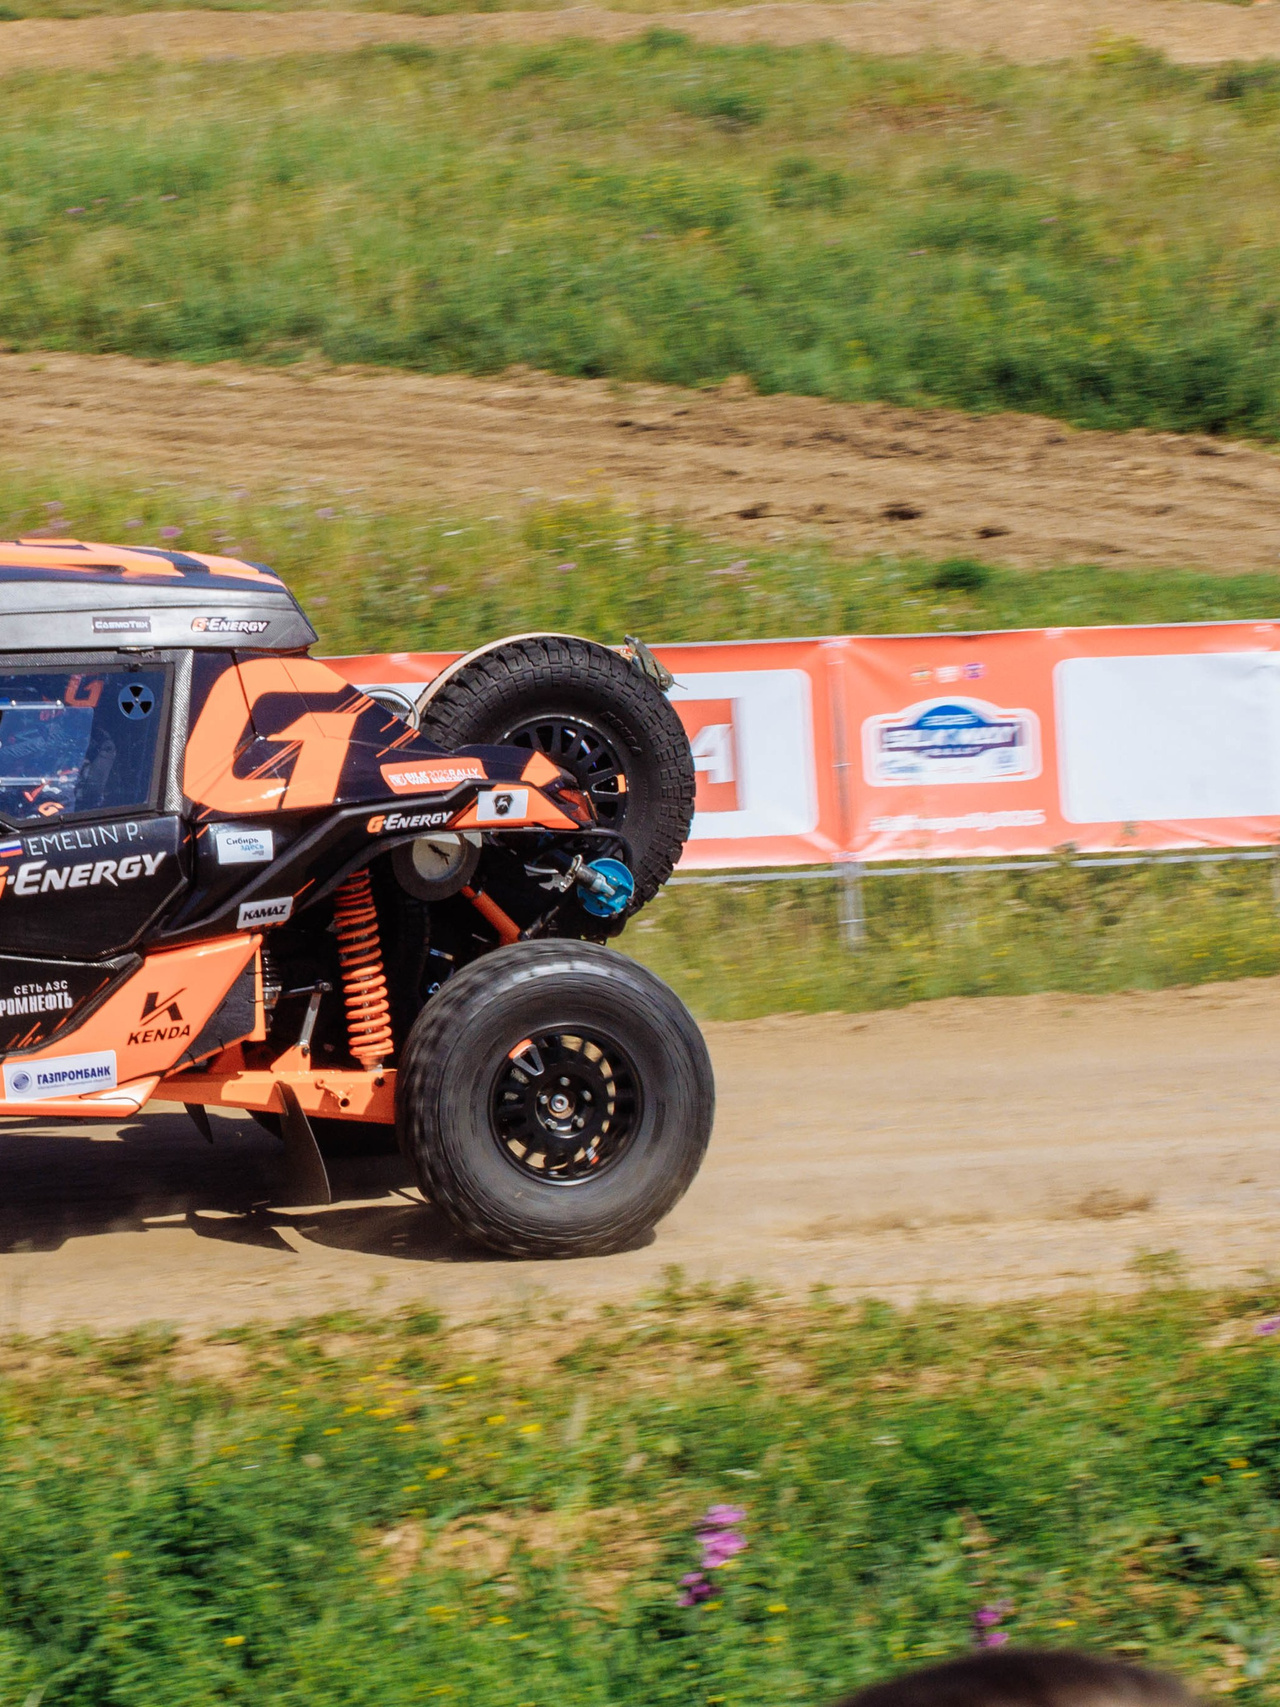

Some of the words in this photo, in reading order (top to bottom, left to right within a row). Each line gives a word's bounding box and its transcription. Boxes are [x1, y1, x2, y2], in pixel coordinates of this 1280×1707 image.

[366, 811, 455, 834] G-ENERGY
[27, 825, 119, 857] EMELIN
[127, 821, 145, 842] P.
[225, 837, 260, 847] Сибирь
[242, 904, 288, 921] KAMAZ
[13, 983, 43, 995] СЕТЬ
[45, 980, 68, 992] АЗС
[127, 1024, 191, 1046] KENDA
[36, 1065, 111, 1085] ГАЗПРОМБАНК
